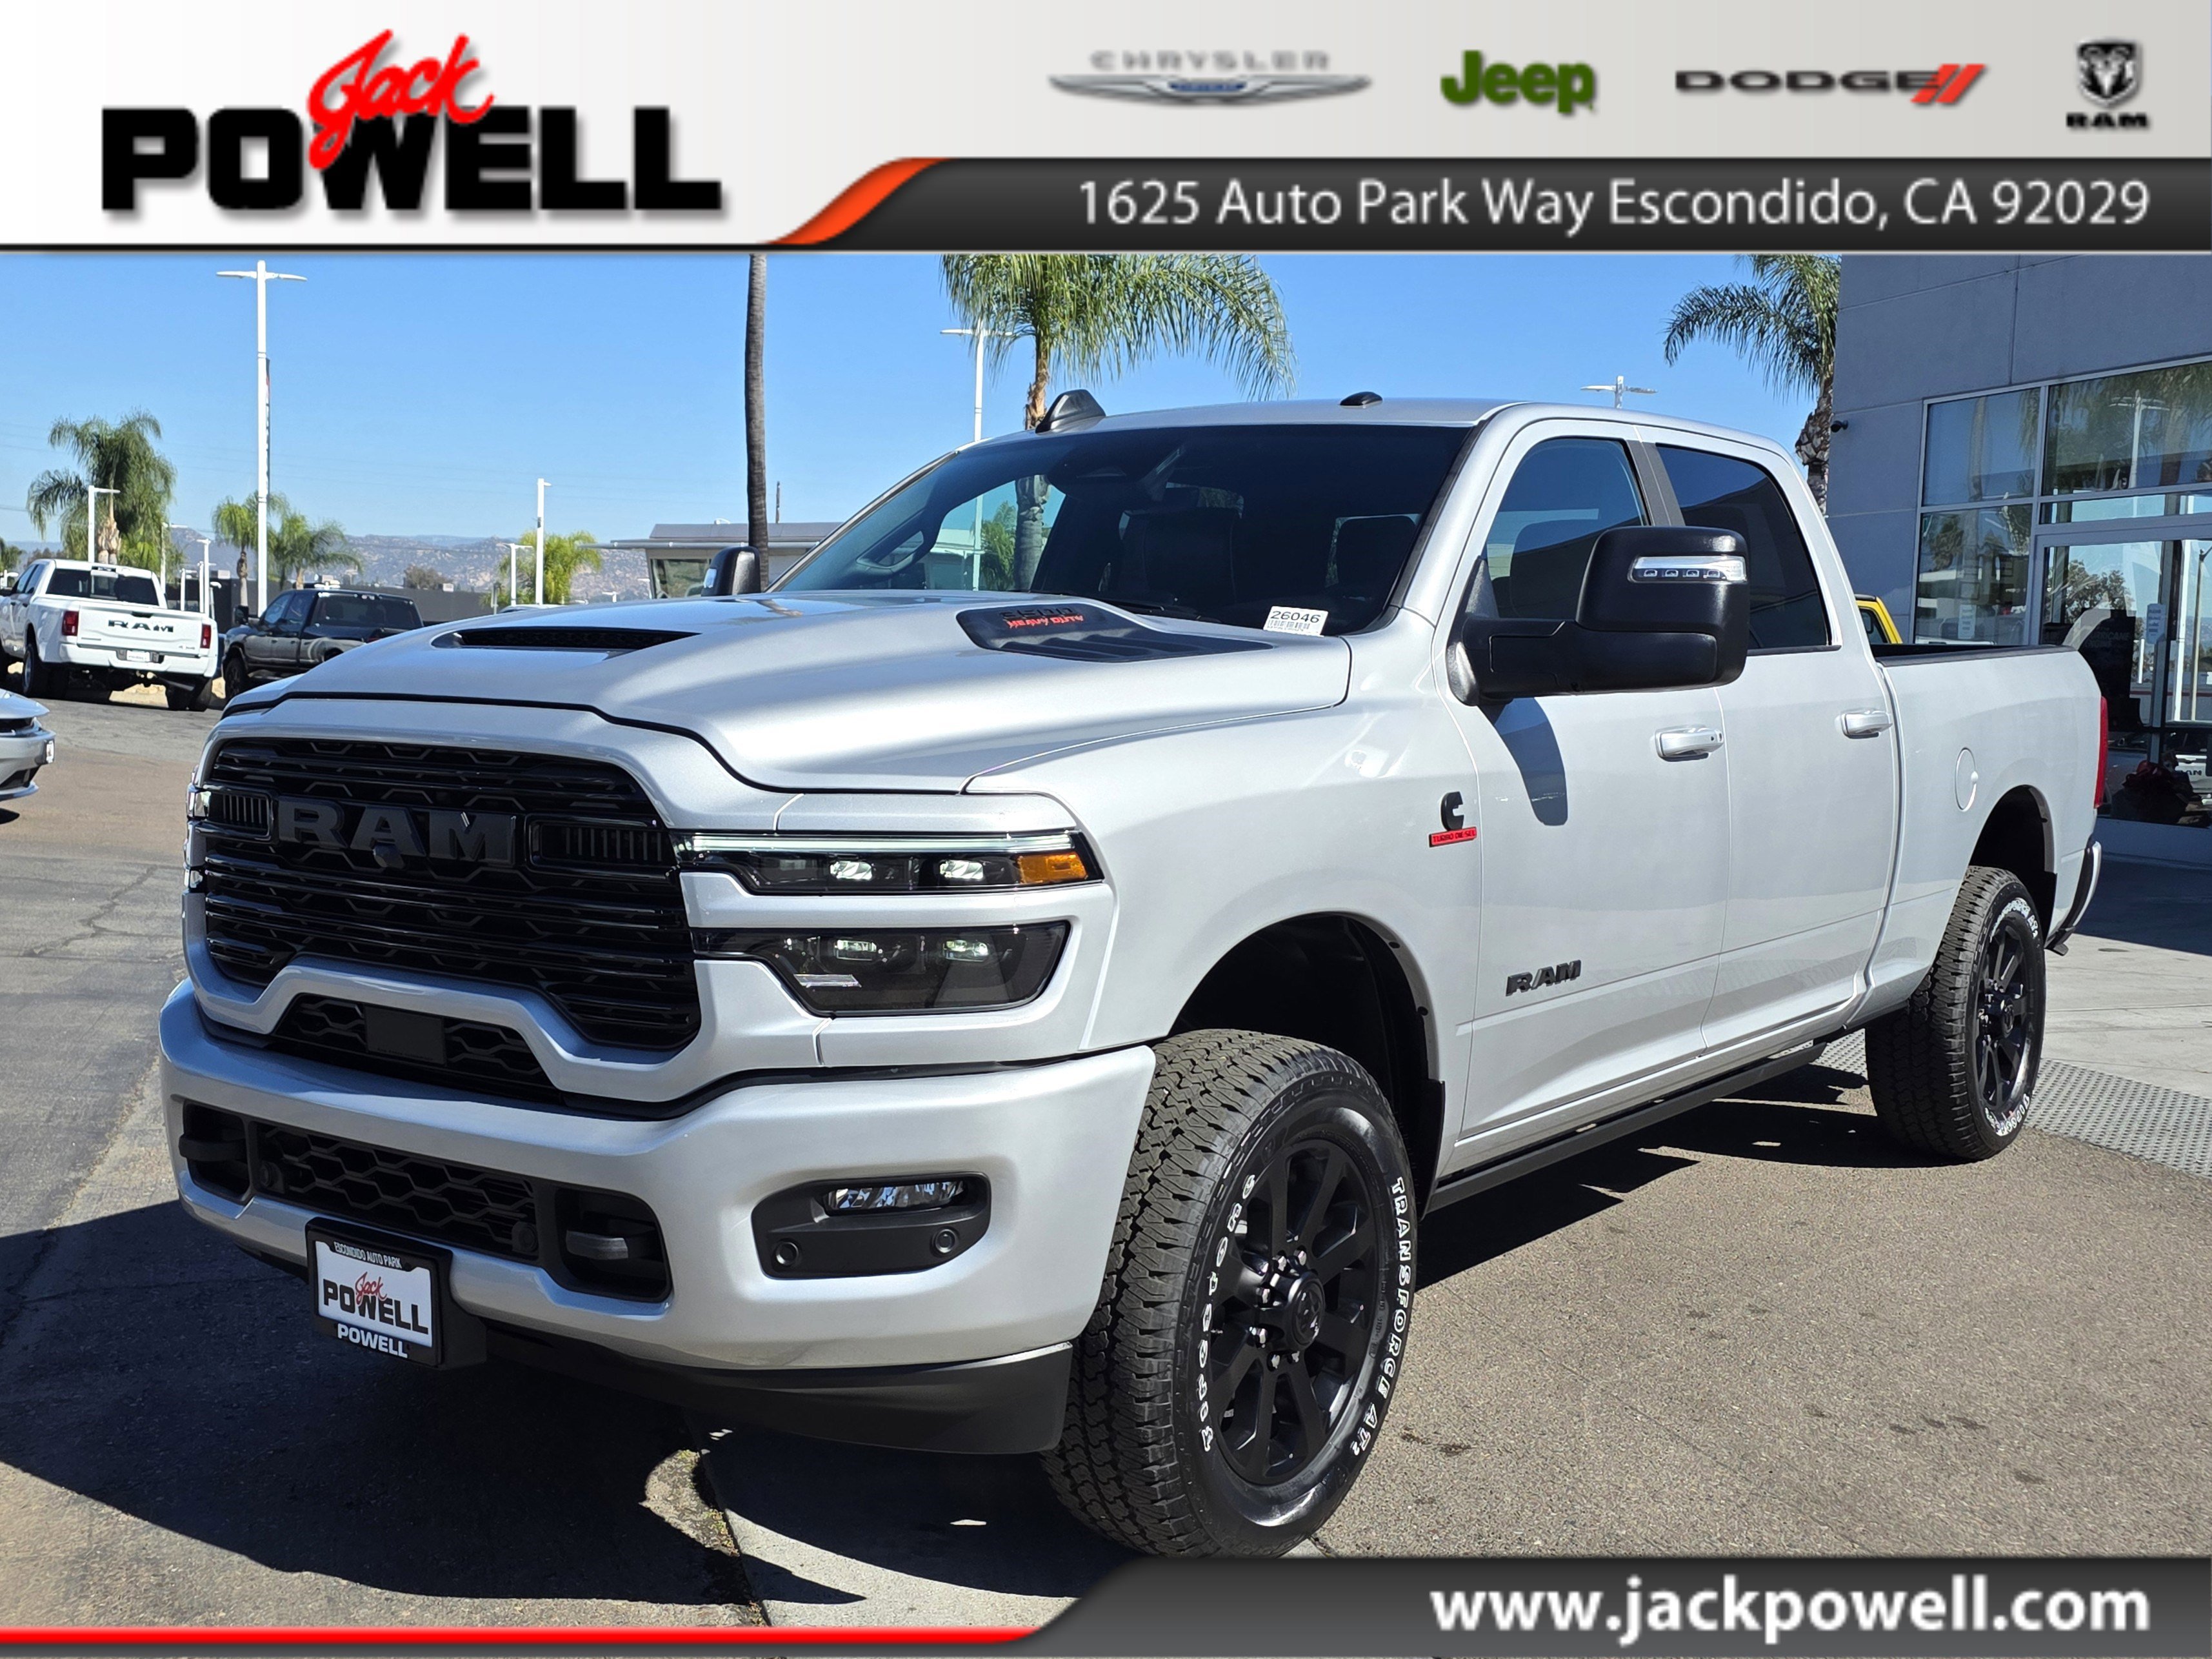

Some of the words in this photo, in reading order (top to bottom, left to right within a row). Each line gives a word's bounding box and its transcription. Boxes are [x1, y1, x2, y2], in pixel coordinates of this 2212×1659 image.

[108, 619, 174, 633] RAM
[1007, 618, 1048, 628] HEAVY
[1050, 615, 1084, 624] DUTY
[1270, 610, 1321, 623] 26046
[277, 794, 517, 865] RAM
[1505, 959, 1582, 996] RAM
[334, 1242, 366, 1260] ESCONDIDO
[366, 1251, 383, 1265] AUTO
[384, 1255, 402, 1268] PARK
[355, 1271, 387, 1305] Jack
[1377, 1176, 1412, 1399] TRANSFORCE
[324, 1279, 428, 1334] POWELL
[338, 1323, 408, 1358] POWELL
